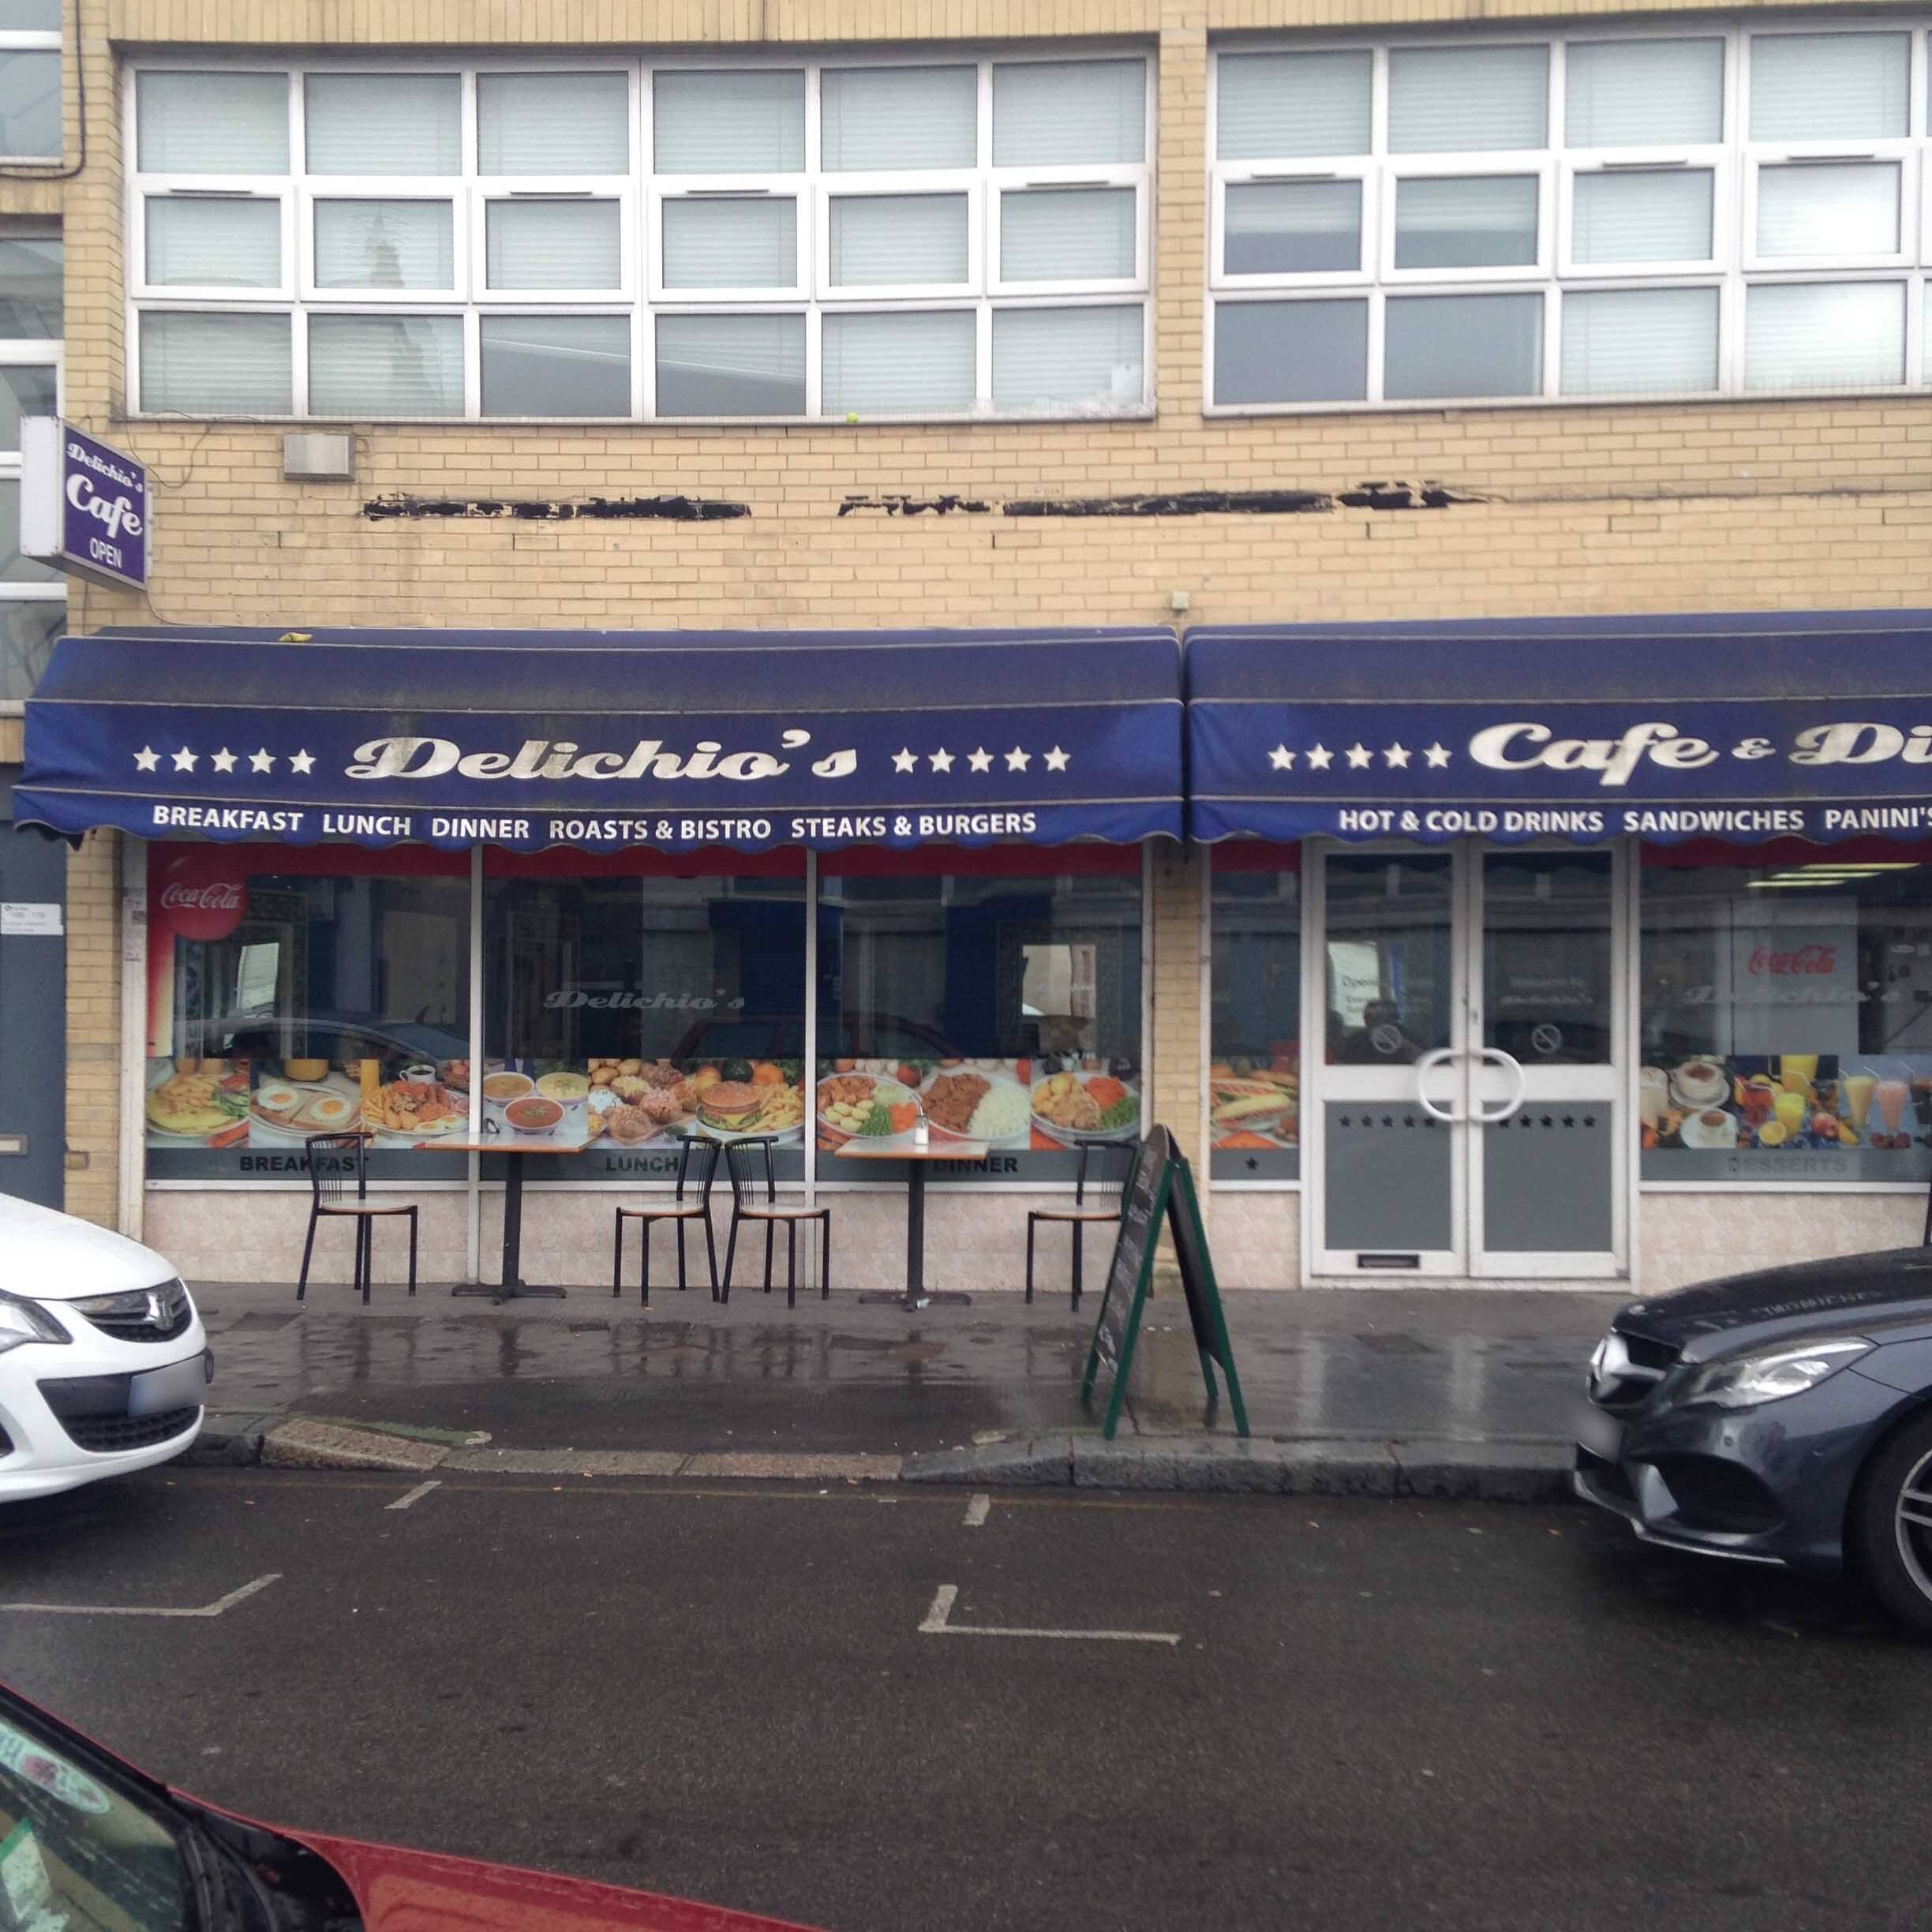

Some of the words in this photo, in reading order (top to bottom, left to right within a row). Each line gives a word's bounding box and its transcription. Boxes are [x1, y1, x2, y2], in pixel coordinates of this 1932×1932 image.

[66, 443, 144, 492] Delichio's
[66, 474, 144, 538] Cafe
[89, 538, 122, 569] OPEN
[345, 729, 857, 781] Delichio's
[1469, 722, 1720, 786] Cafe
[1732, 738, 1776, 760] &
[152, 805, 304, 832] BREAKFAST
[323, 814, 411, 836] LUNCH
[432, 818, 530, 839] DINNER
[549, 819, 648, 840] ROASTS
[655, 819, 673, 840] &
[680, 819, 772, 840] BISTRO
[792, 816, 886, 838] STEAKS
[893, 815, 912, 837] &
[919, 812, 1036, 836] BURGERS
[1339, 810, 1395, 831] HOT
[1399, 810, 1420, 831] &
[1425, 811, 1498, 832] COLD
[1504, 811, 1604, 833] DRINKS
[1623, 810, 1805, 832] SANDWICHES
[543, 988, 745, 1009] Delichio's
[605, 1156, 678, 1172] LUNCH
[1728, 1155, 1848, 1174] DESSERTS
